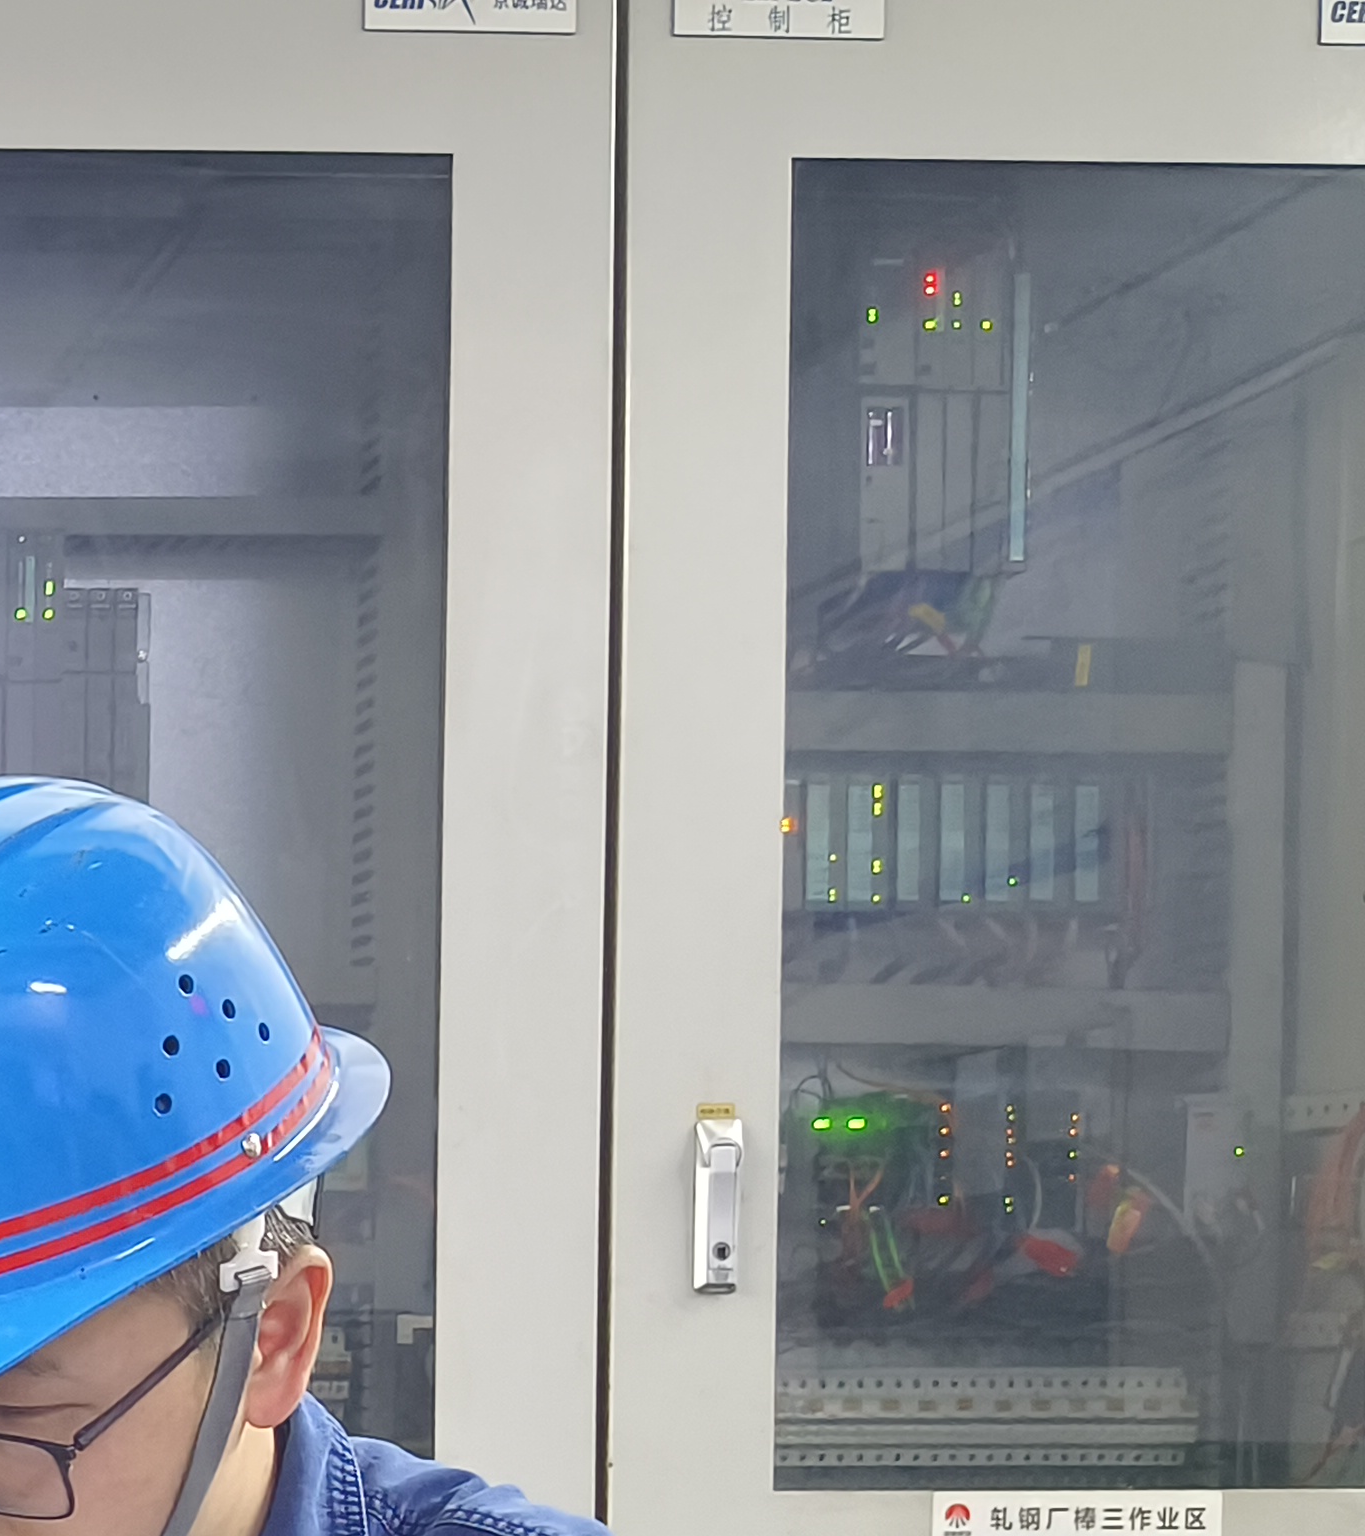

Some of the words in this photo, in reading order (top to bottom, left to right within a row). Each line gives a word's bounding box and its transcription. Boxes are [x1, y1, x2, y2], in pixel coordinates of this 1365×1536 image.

[708, 5, 853, 34] 控制柜
[989, 1506, 1207, 1531] 轧钢厂棒三作业区
